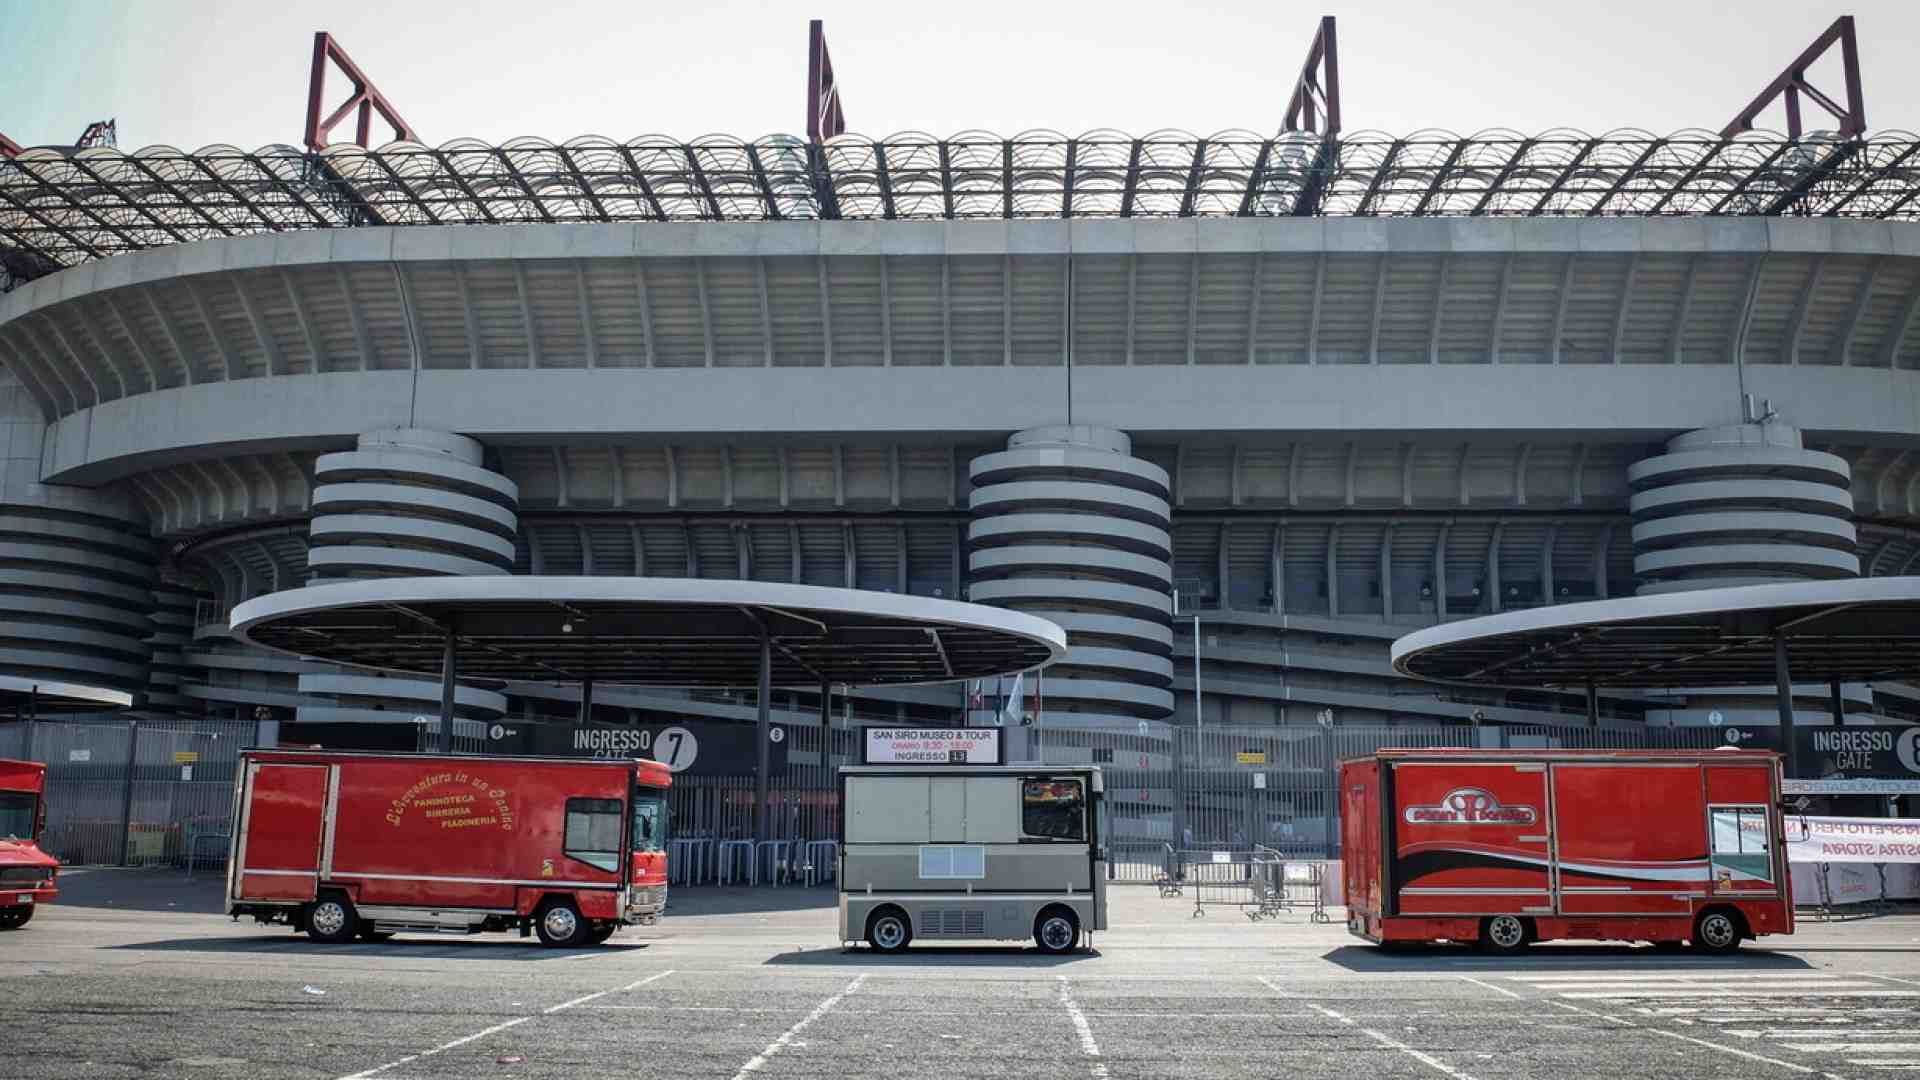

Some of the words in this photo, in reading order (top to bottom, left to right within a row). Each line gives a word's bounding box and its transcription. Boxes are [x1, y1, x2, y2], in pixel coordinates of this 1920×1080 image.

[574, 729, 651, 750] INGRESSO
[873, 731, 893, 740] SAN
[895, 731, 918, 740] SIRO
[920, 731, 954, 740] MUSEO
[964, 731, 991, 740] TOUR
[1814, 731, 1892, 751] INGRESSO
[668, 733, 684, 765] 7
[894, 752, 946, 761] INGRESSO
[1837, 752, 1872, 769] GATE
[414, 794, 475, 807] PANINOTECA
[426, 807, 471, 817] BIRRERIA
[441, 816, 497, 828] PIADINERIA
